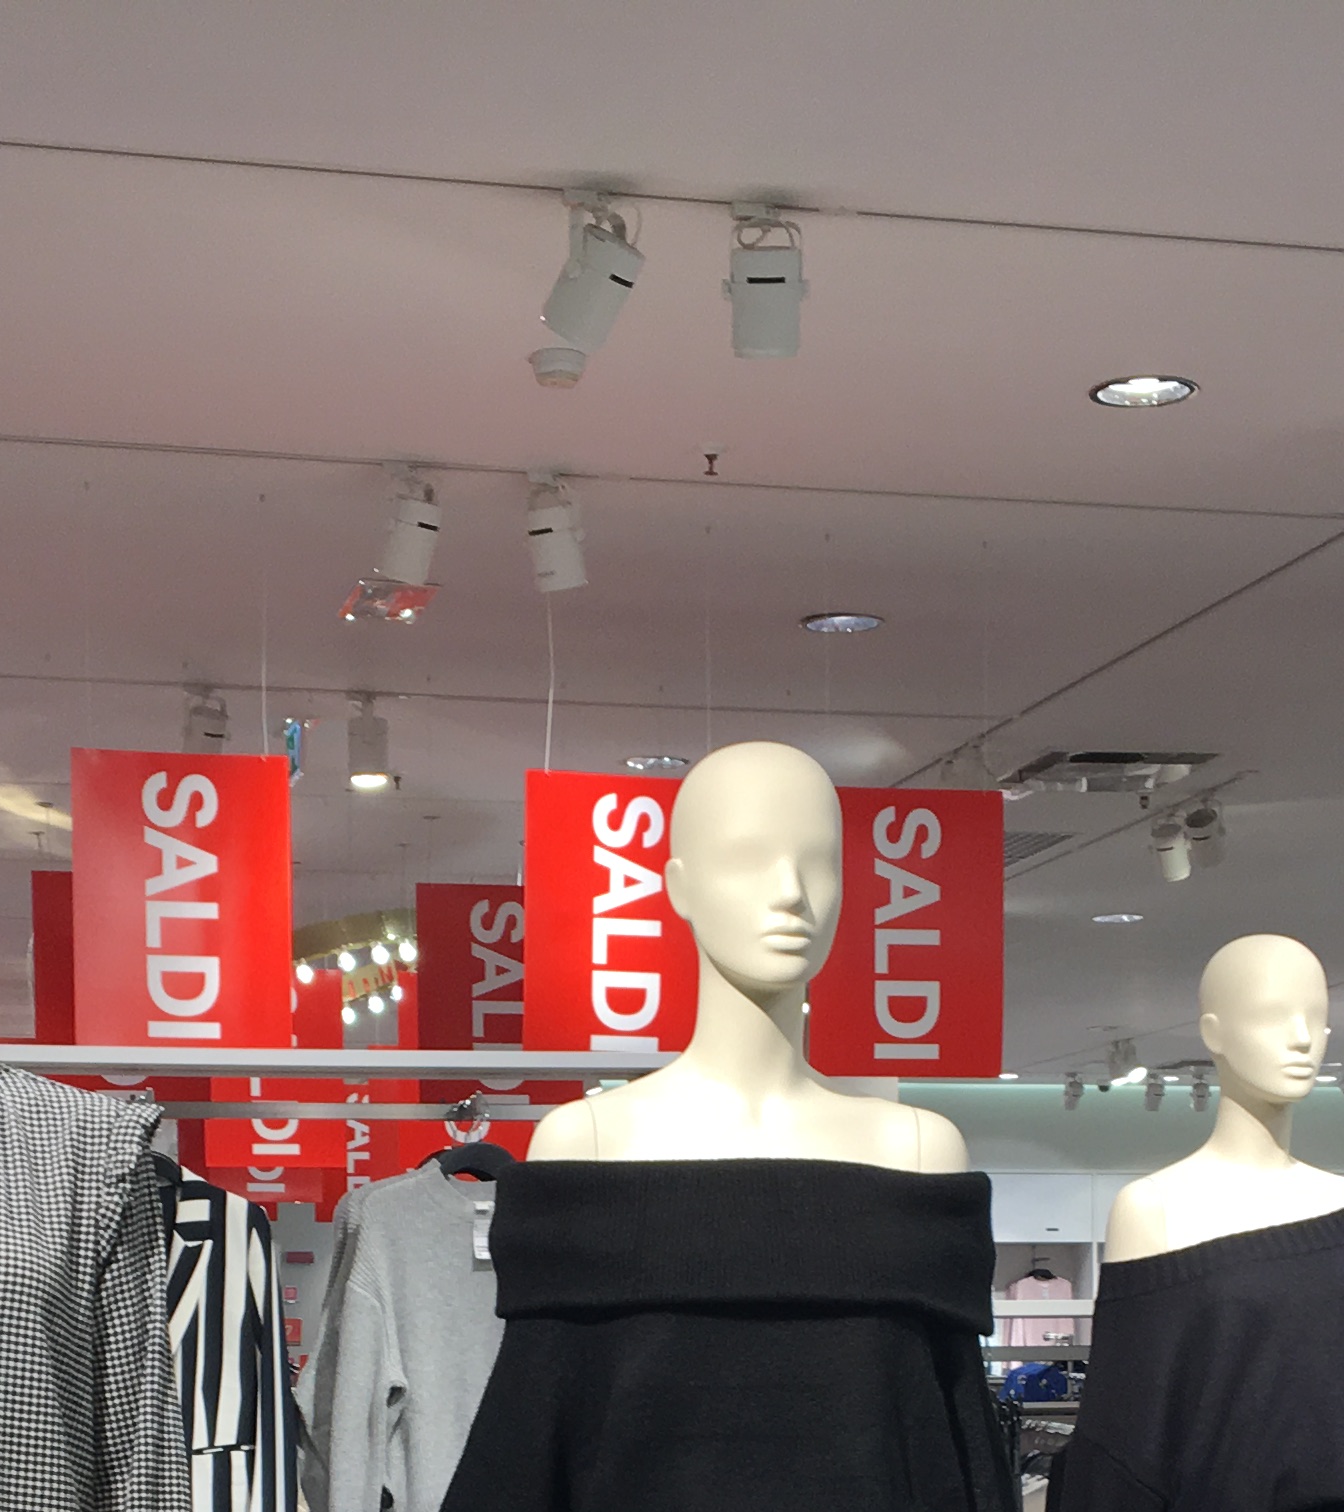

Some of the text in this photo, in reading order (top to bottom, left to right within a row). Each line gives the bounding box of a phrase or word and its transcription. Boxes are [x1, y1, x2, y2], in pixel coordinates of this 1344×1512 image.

[141, 770, 222, 1040] SALDI
[590, 792, 665, 1052] SALDI
[871, 806, 942, 1060] SALDI
